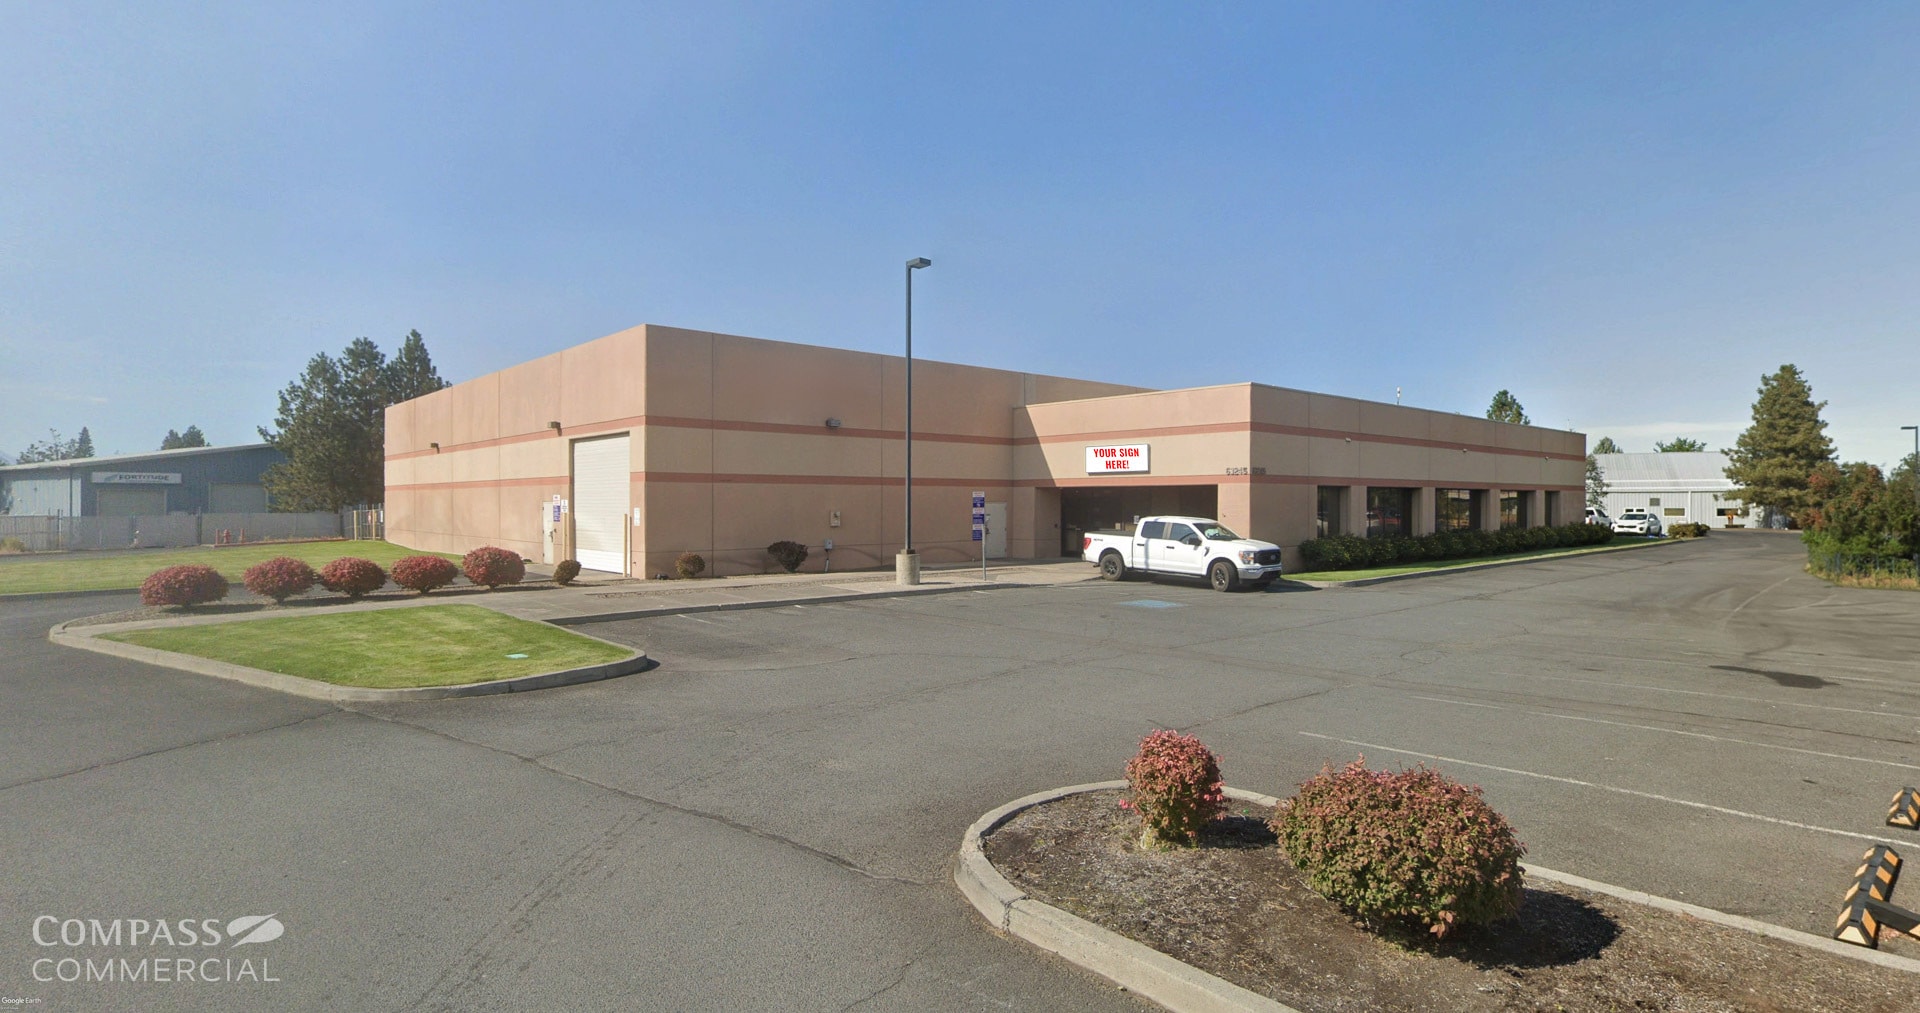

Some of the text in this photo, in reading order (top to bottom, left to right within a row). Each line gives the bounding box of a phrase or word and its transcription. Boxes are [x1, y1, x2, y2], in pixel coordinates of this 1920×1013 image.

[1093, 447, 1140, 458] YOUR SIGN
[1105, 460, 1130, 469] HERE!
